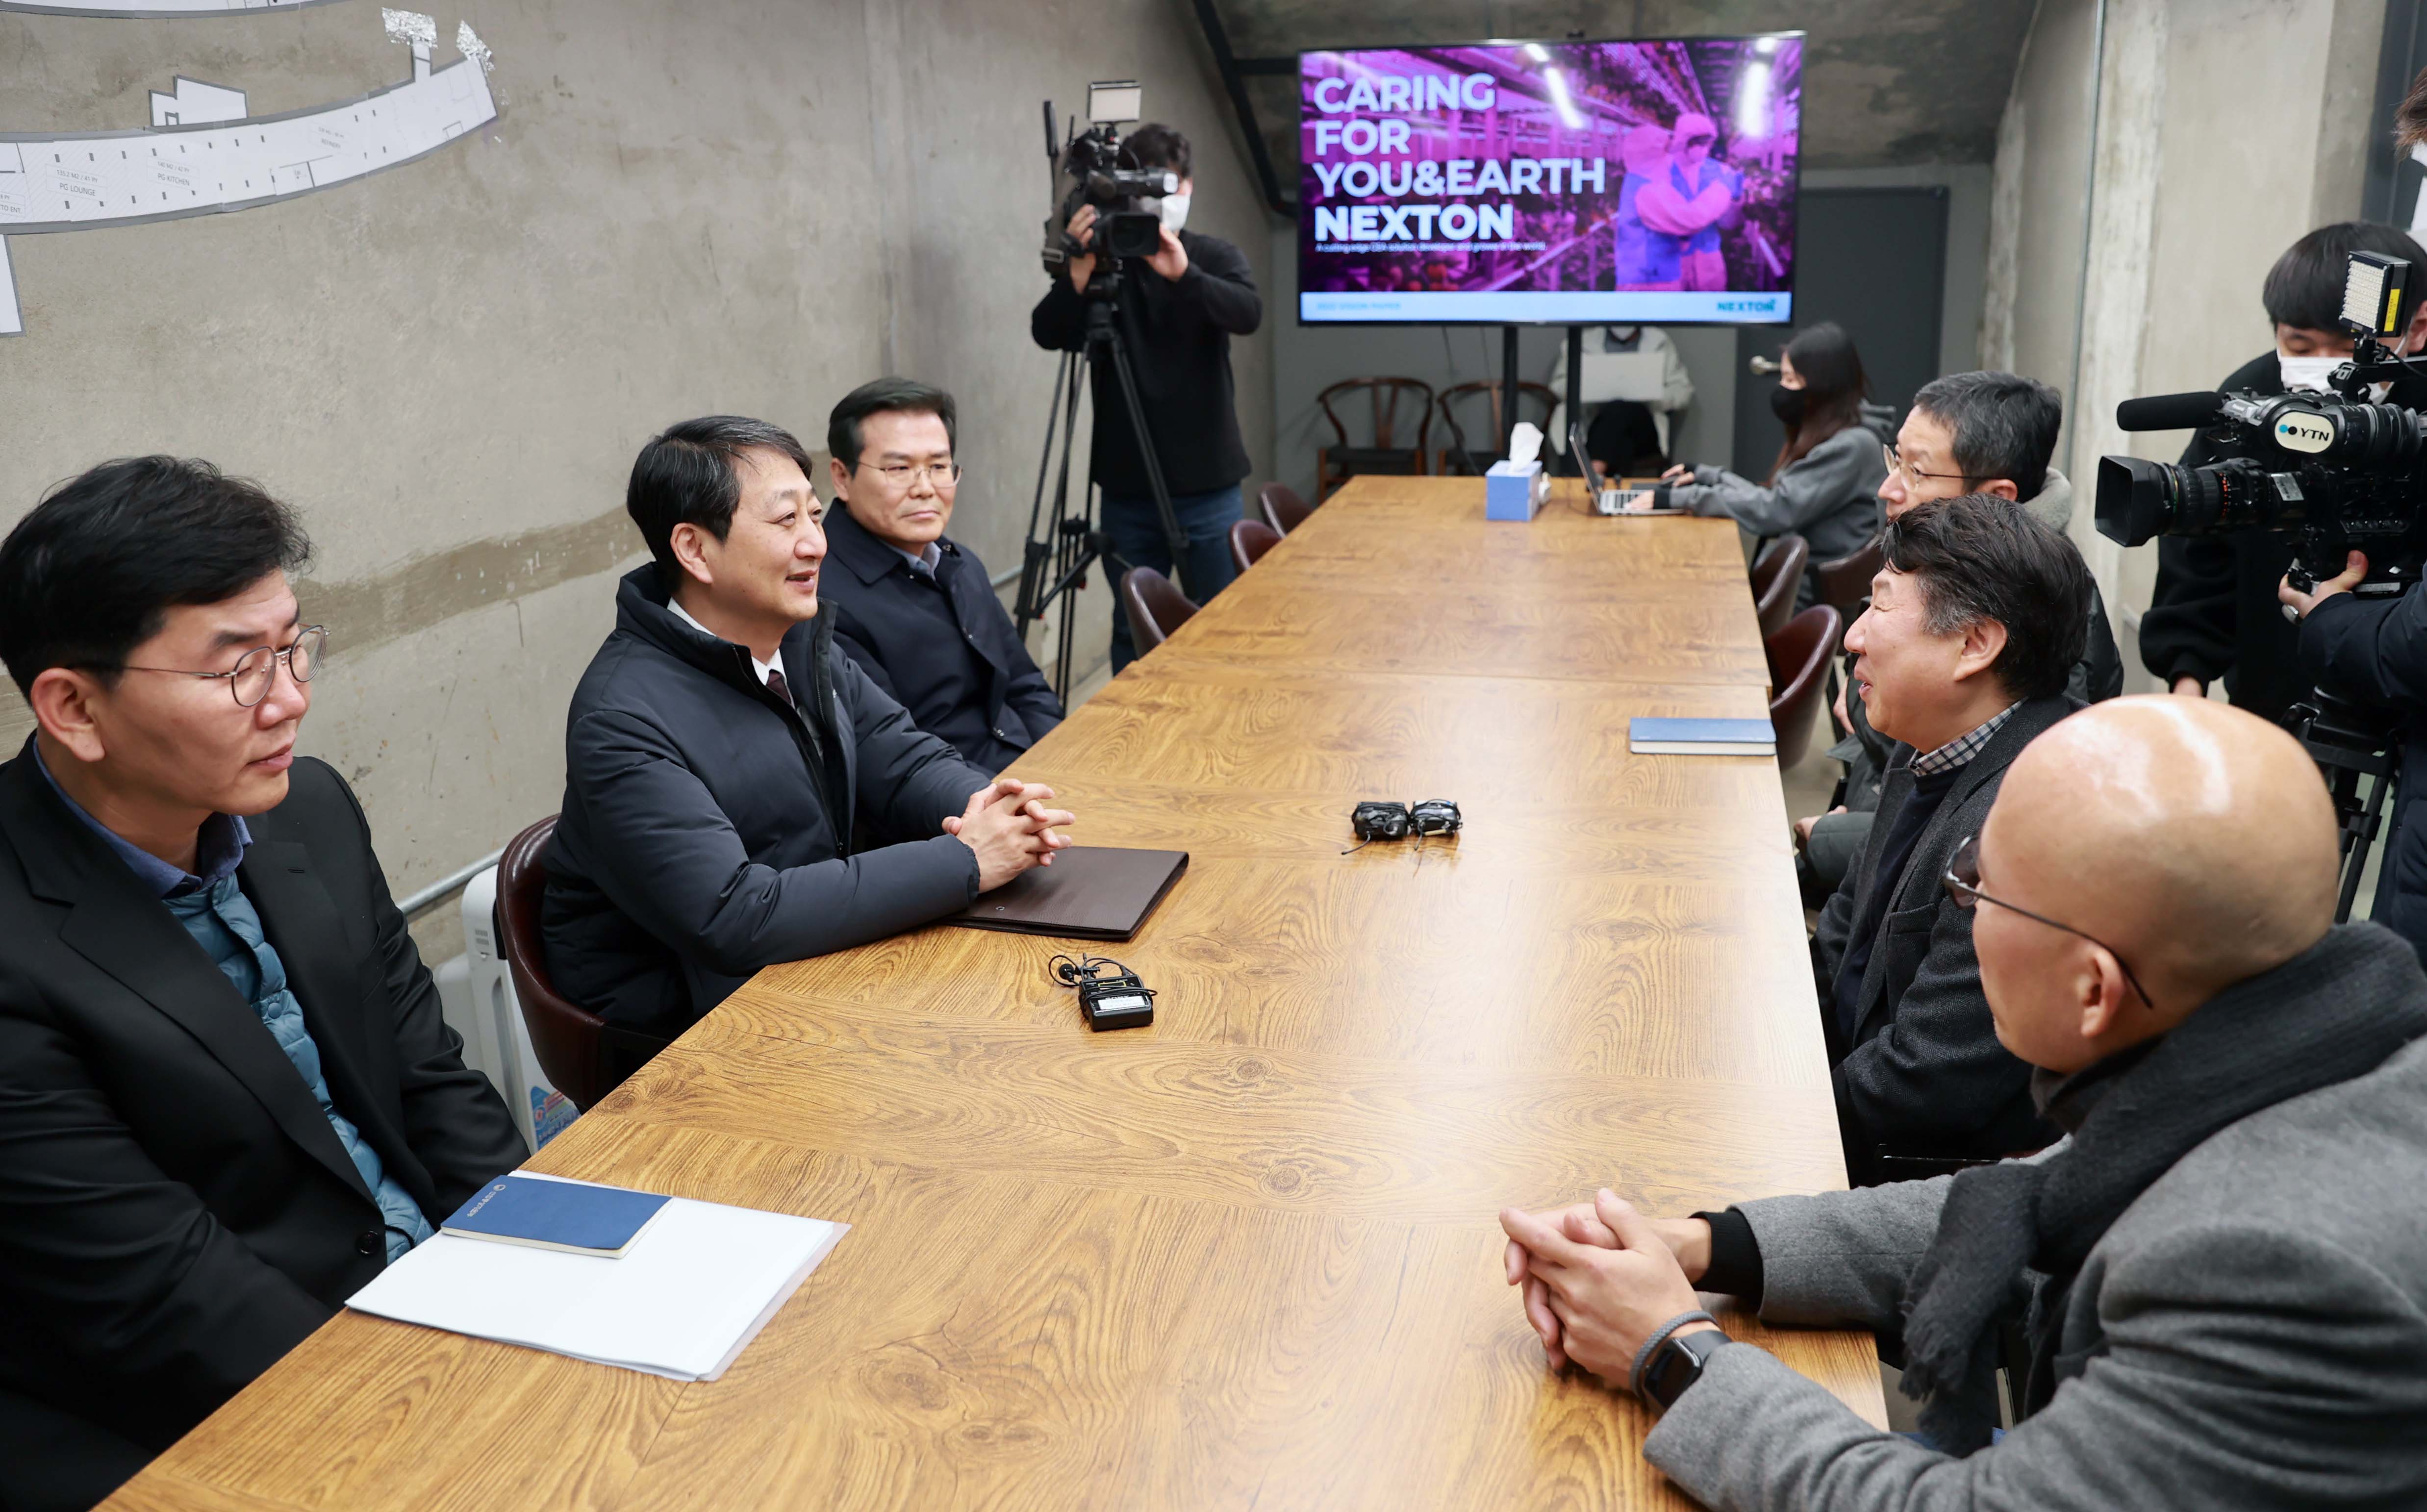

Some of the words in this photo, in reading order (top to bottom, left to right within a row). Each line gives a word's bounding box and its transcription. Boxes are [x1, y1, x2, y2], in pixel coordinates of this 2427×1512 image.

[1314, 73, 1496, 114] CARING
[1315, 118, 1411, 156] FOR
[70, 185, 96, 196] LOUNGE
[167, 176, 190, 186] KITCHEN
[1312, 158, 1605, 197] YOU&EARTH
[1315, 203, 1513, 241] NEXTON
[1718, 300, 1775, 312] NEXTON
[2301, 428, 2329, 442] YTN
